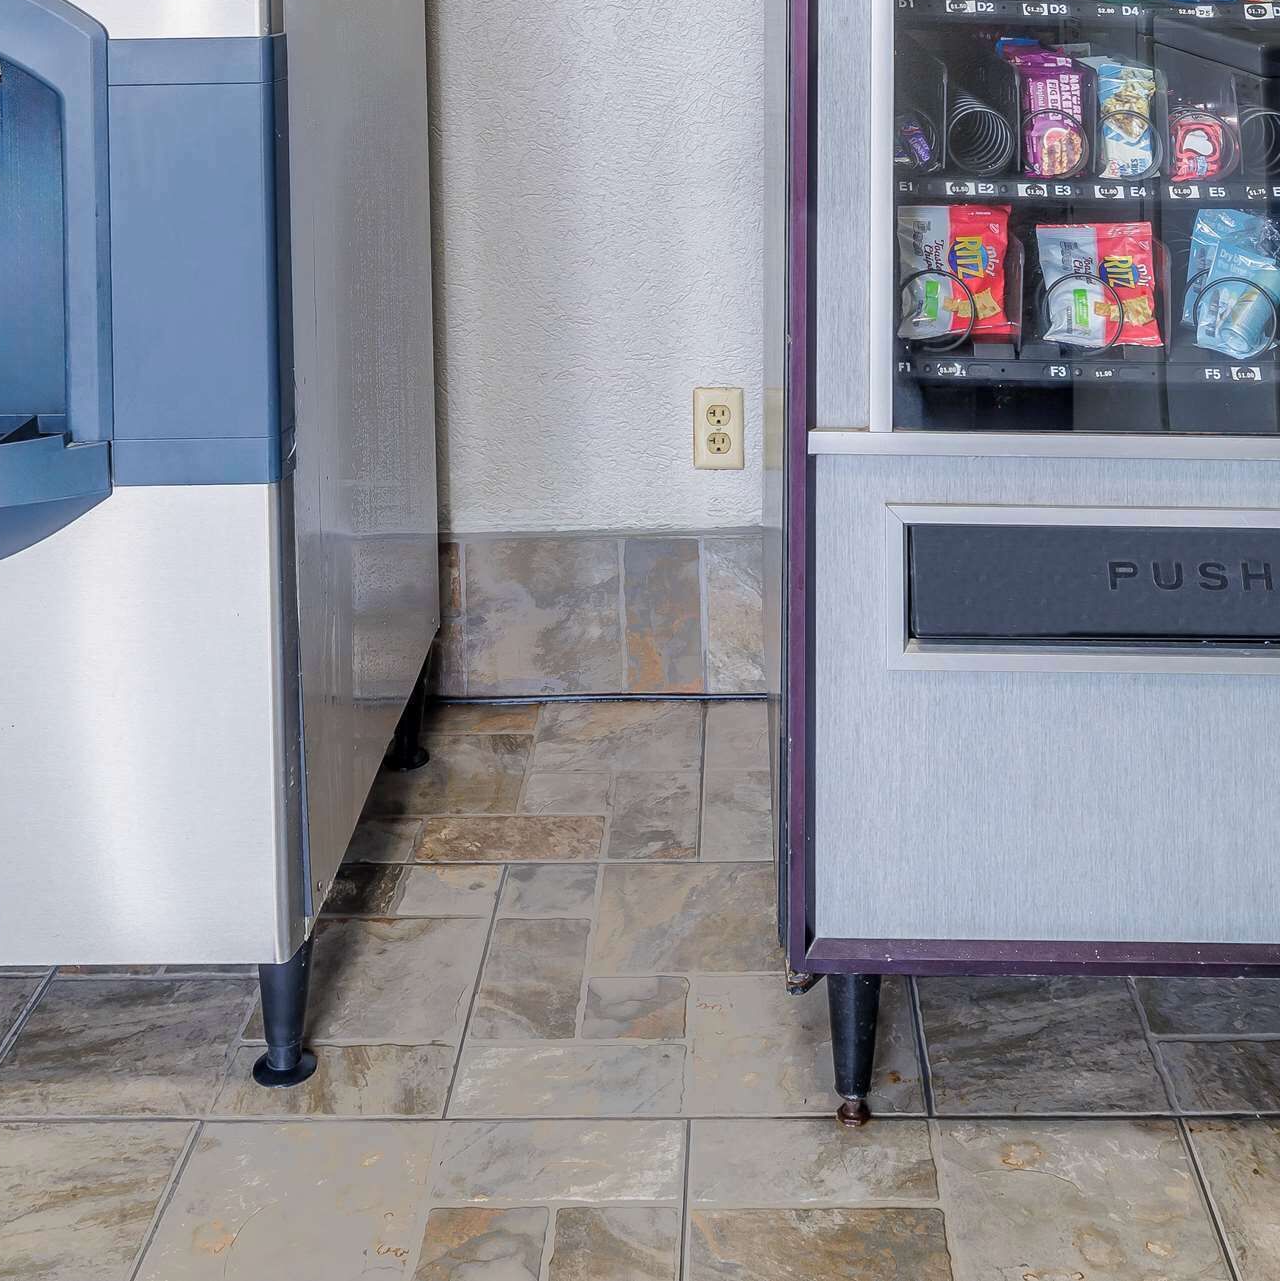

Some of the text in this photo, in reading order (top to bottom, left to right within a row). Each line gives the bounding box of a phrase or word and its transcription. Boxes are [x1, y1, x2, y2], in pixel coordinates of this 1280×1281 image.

[977, 3, 994, 12] D2
[1050, 4, 1067, 13] D3
[1122, 6, 1139, 15] D4
[1048, 82, 1056, 96] FIG
[899, 182, 913, 191] E1
[978, 184, 994, 193] E2
[1055, 186, 1070, 195] E3
[1130, 187, 1146, 196] E4
[1209, 187, 1225, 197] E5
[955, 236, 984, 280] RITZ
[1104, 255, 1135, 288] RITZ
[898, 363, 910, 372] F1
[1050, 367, 1066, 376] F3
[1205, 369, 1220, 380] F5
[1107, 560, 1274, 591] PUSH
